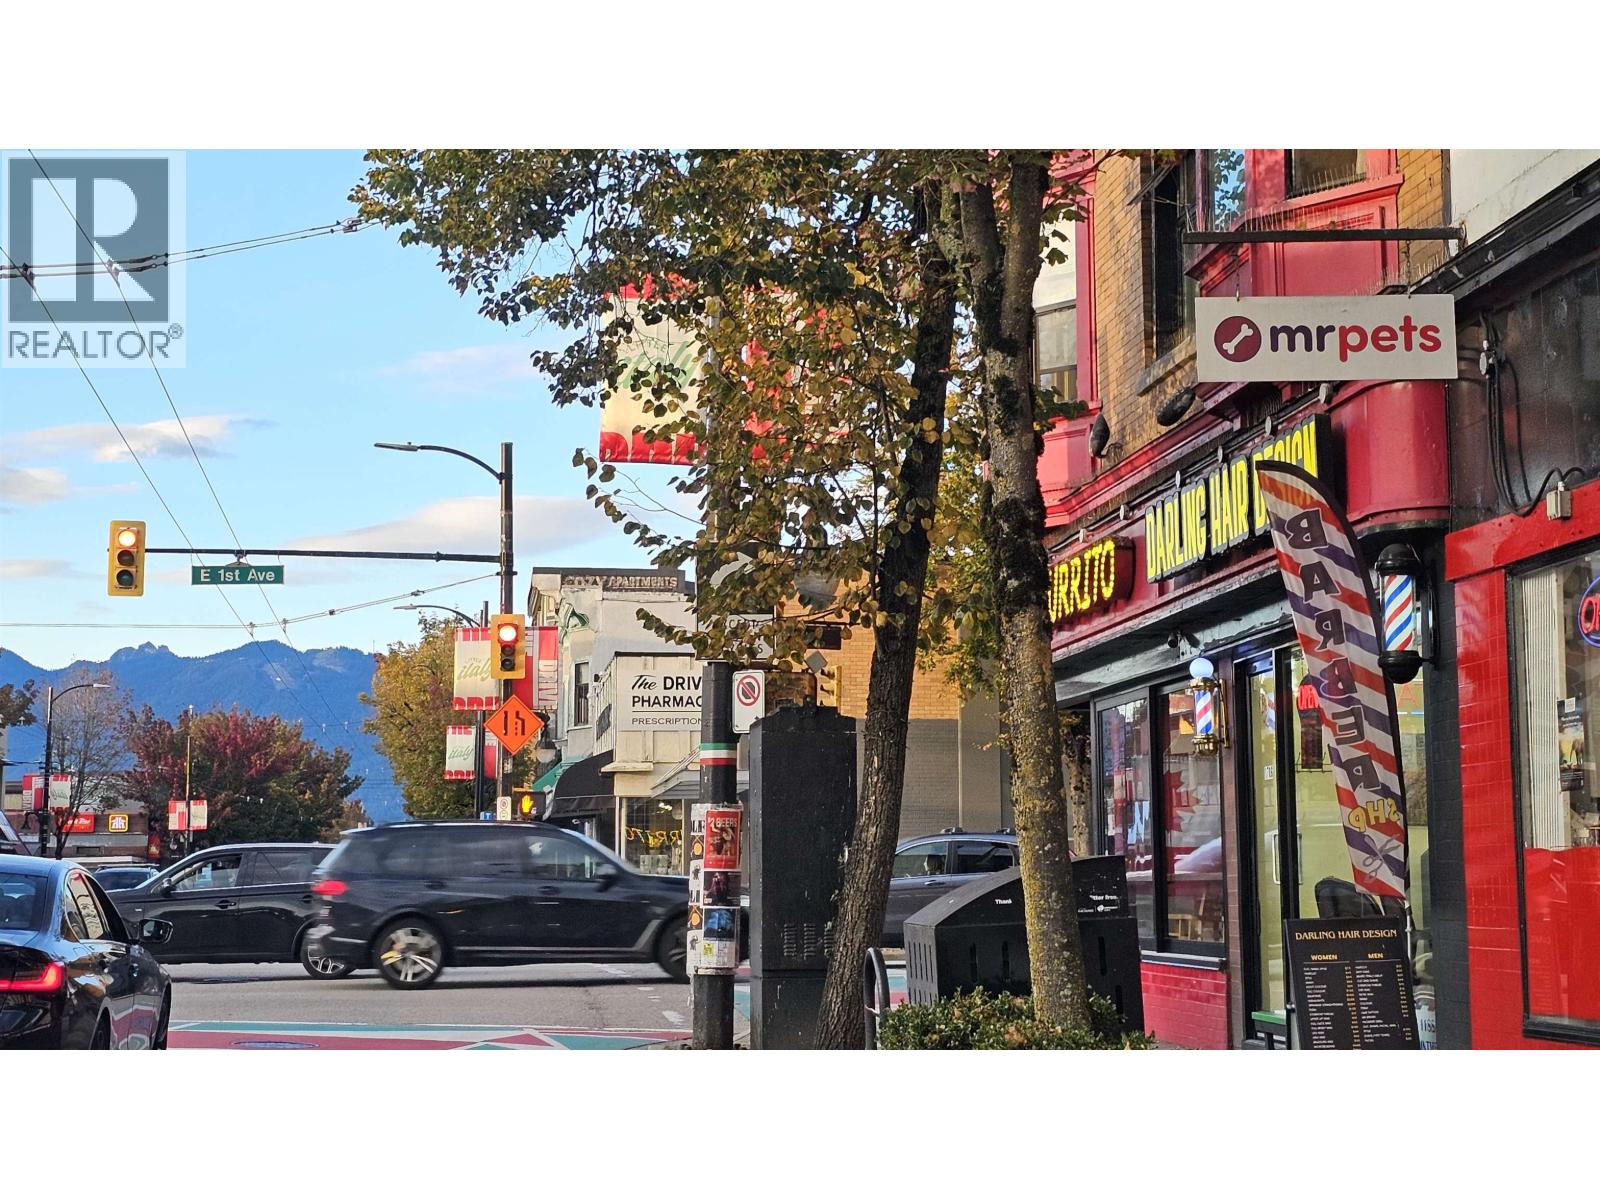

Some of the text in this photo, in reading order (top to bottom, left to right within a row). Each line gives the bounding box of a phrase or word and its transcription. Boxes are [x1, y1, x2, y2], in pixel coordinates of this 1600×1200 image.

[1269, 315, 1442, 362] mrpets
[1146, 483, 1206, 582] DARLING
[1209, 458, 1249, 555] HAIR
[200, 568, 275, 581] E 1st Ave
[608, 576, 678, 588] APARTMENTS
[632, 674, 657, 690] The
[716, 817, 738, 828] BEERS
[1295, 929, 1397, 940] DARLING HAIR DESIGN
